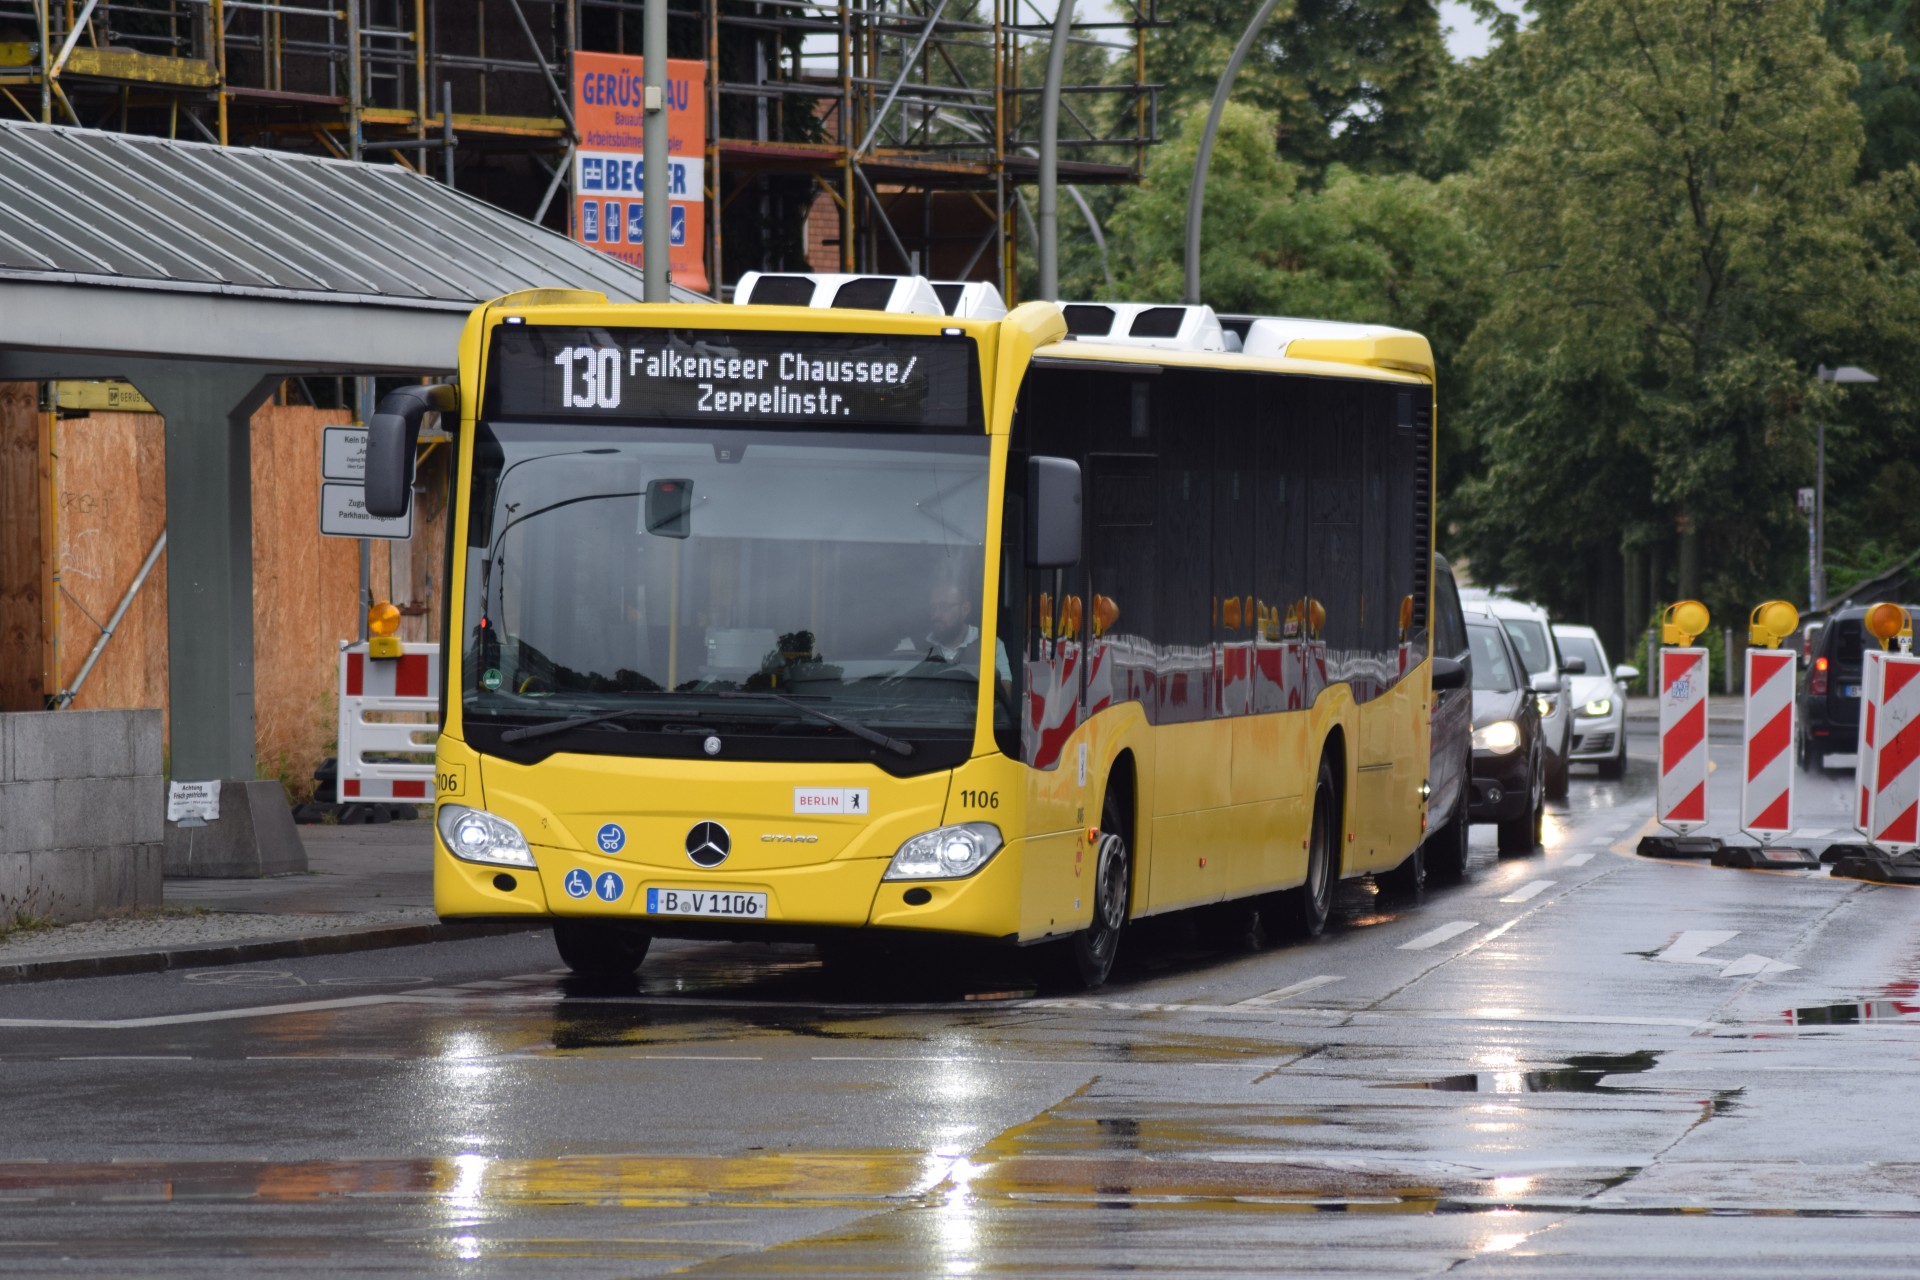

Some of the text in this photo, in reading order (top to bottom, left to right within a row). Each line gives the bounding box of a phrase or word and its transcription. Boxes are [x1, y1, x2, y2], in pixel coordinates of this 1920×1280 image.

[554, 347, 917, 408] 130 Falkenseer Chaussee/
[698, 383, 850, 415] Zeppelinstr.
[344, 435, 360, 444] Kein
[339, 510, 370, 520] Parkhaus
[799, 796, 839, 806] BERLIN
[960, 790, 999, 809] 1106
[760, 834, 819, 843] CITARO
[666, 892, 678, 911] B
[692, 894, 705, 913] V
[709, 894, 758, 914] 1106
